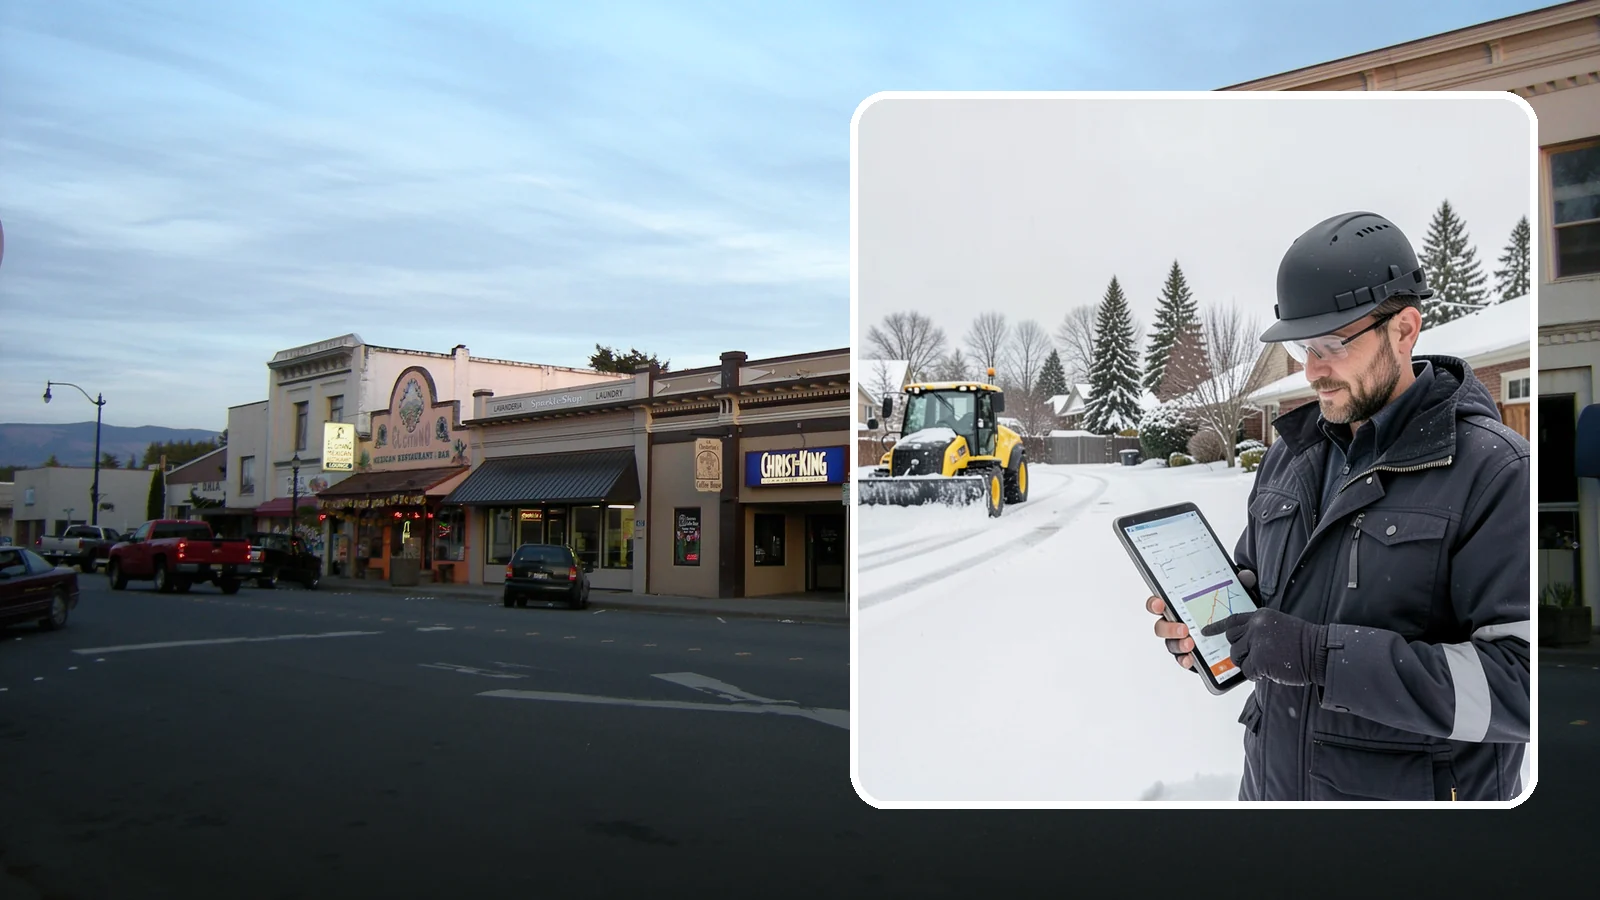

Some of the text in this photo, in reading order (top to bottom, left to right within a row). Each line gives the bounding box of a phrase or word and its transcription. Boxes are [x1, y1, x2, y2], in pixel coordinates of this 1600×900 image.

[562, 394, 582, 404] Shop
[595, 389, 624, 400] LAUNDRY
[493, 402, 522, 412] LAVANDERIA
[373, 455, 396, 464] MEXICAN
[398, 451, 433, 462] RESTAURANT
[438, 450, 450, 459] BAR
[761, 450, 827, 478] CHRIST KING
